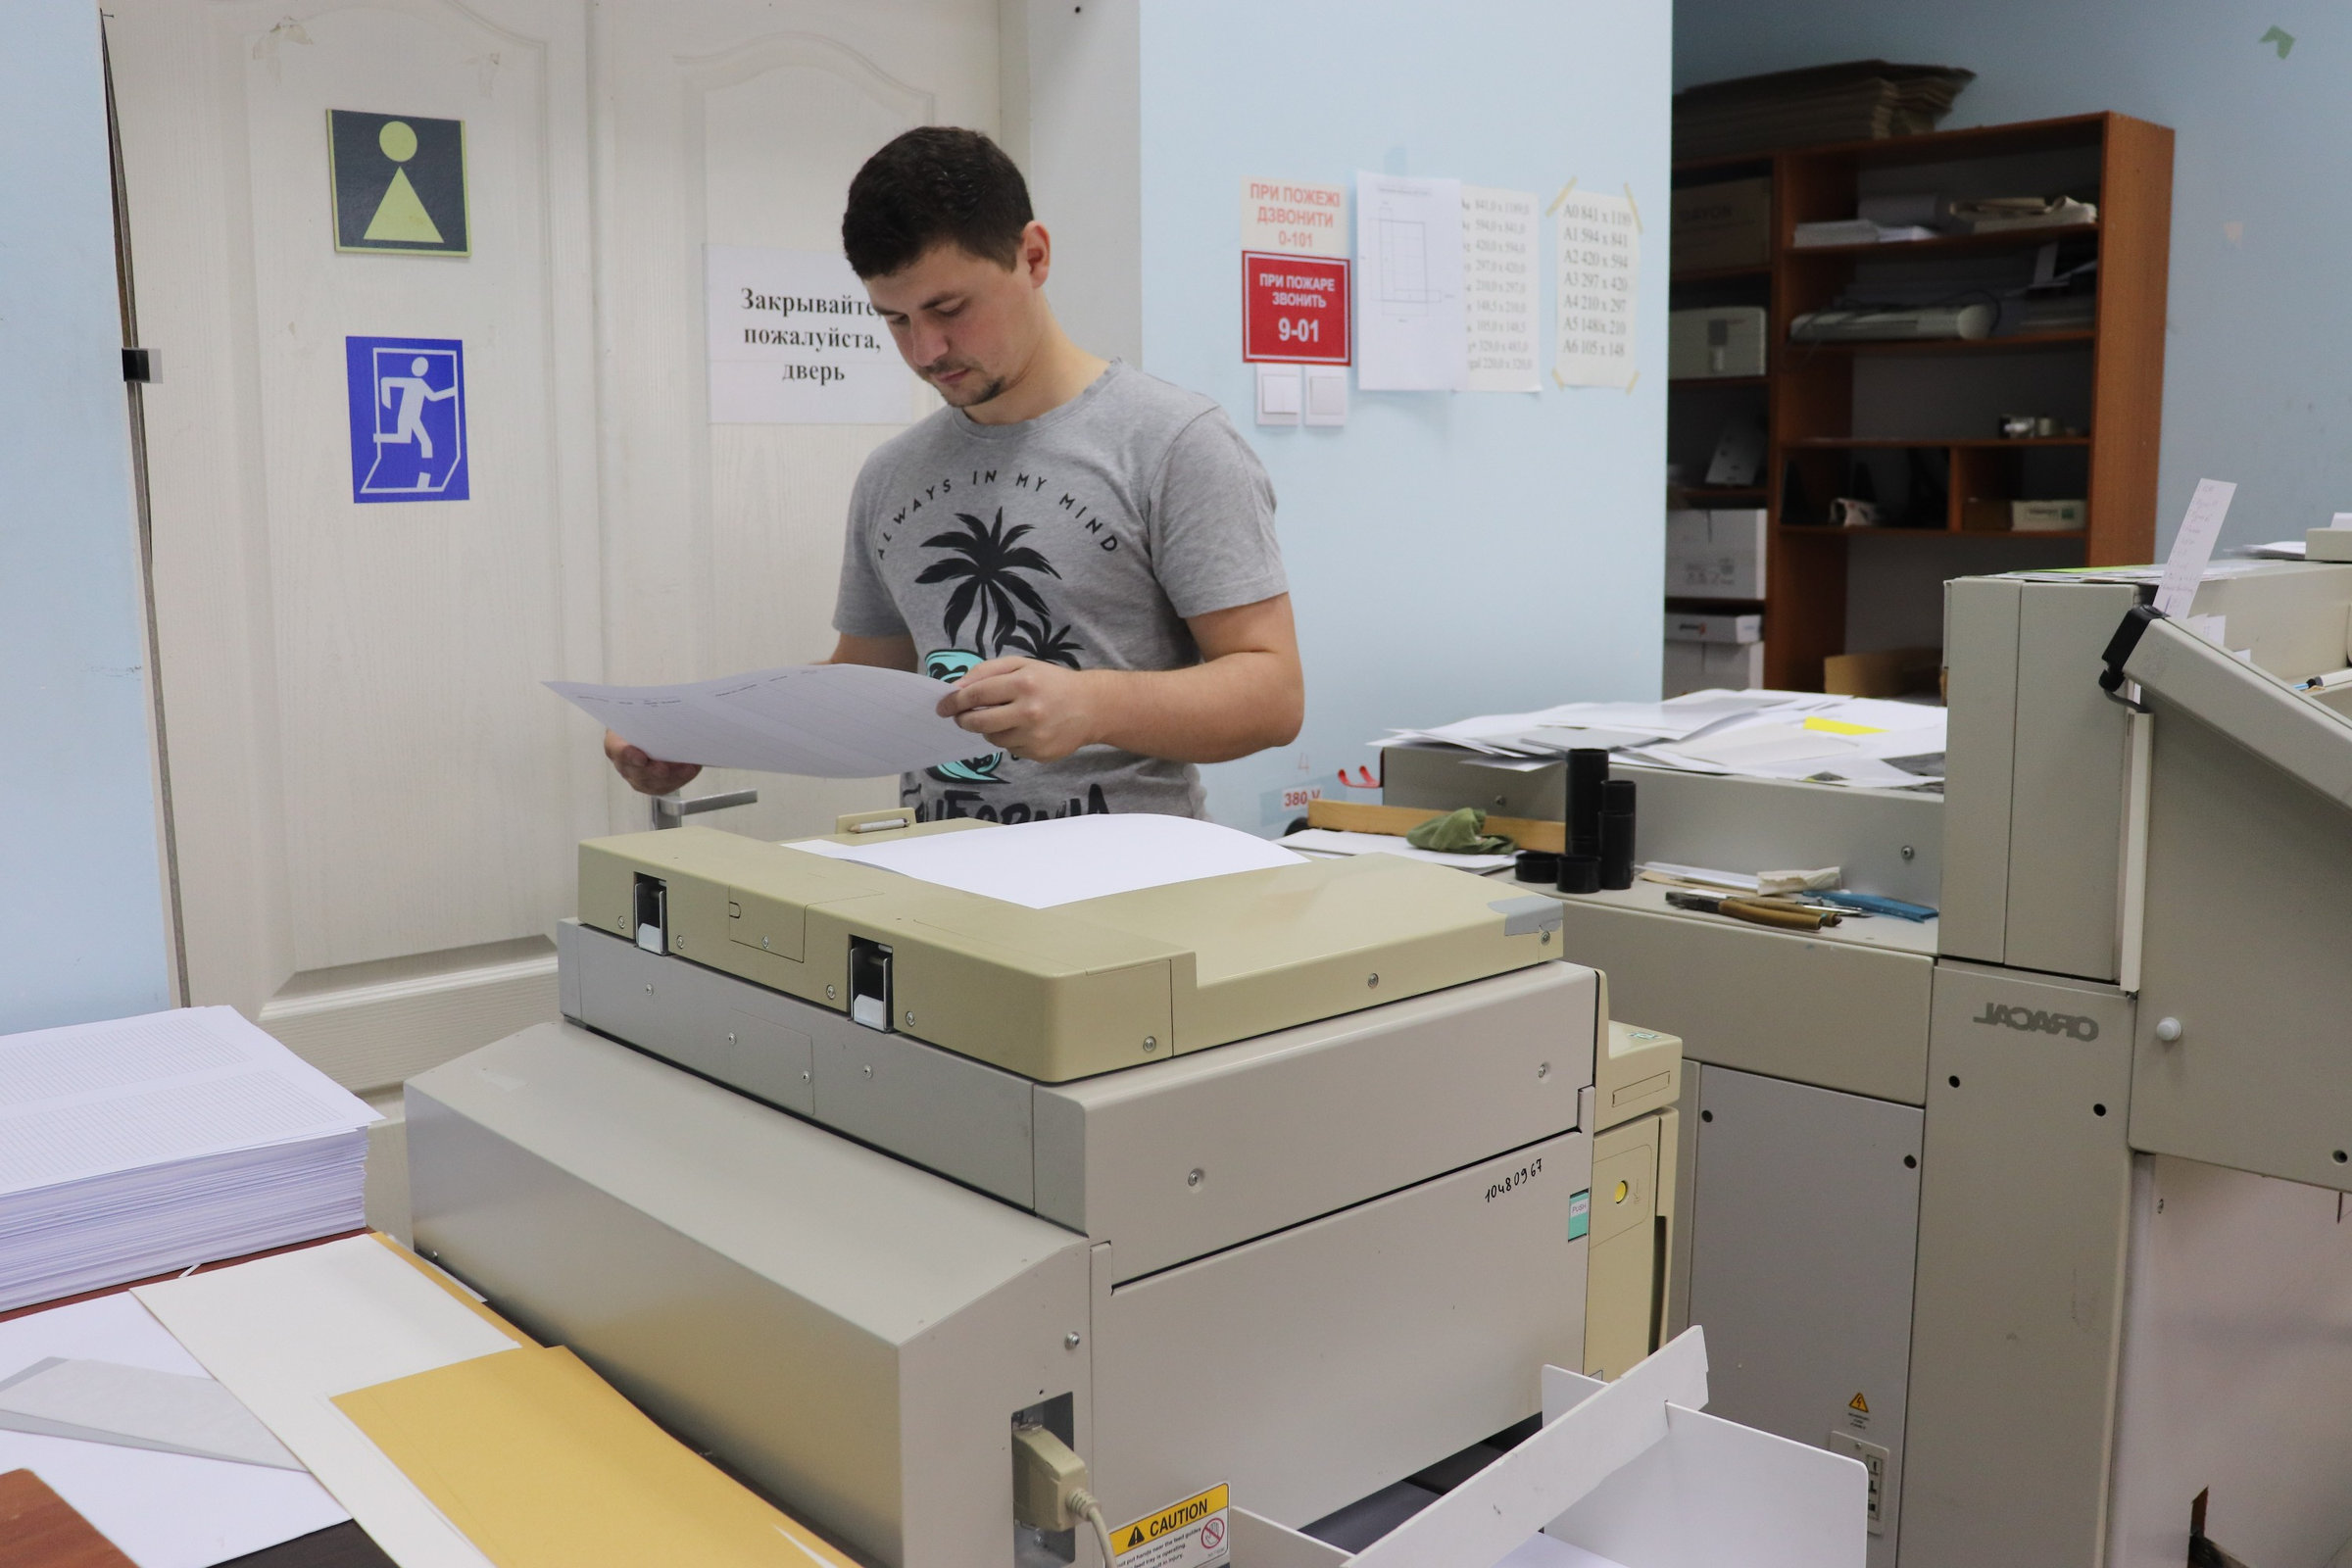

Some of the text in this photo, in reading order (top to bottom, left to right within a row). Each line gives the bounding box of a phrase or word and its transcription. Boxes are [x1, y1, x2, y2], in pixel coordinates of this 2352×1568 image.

[1250, 183, 1279, 202] ПРИ
[1256, 206, 1334, 227] ДЗВОНИТИ
[1563, 204, 1579, 220] A0
[1581, 205, 1597, 221] 841
[1278, 230, 1313, 248] 0-101
[1563, 226, 1577, 242] A1
[1581, 227, 1598, 243] 594
[1611, 231, 1628, 248] 841
[1563, 249, 1579, 265] A2
[1582, 250, 1599, 267] 420
[1610, 254, 1628, 269] 594
[1259, 273, 1336, 292] ПРИ ПОЖАРЕ
[1563, 271, 1578, 287] A3
[1582, 272, 1599, 288] 297
[1610, 276, 1628, 292] 420
[1272, 292, 1327, 309] ЗВОНИТЬ
[1563, 294, 1578, 309] A4
[1581, 295, 1599, 311] 210
[1610, 298, 1627, 313] 297
[1278, 317, 1320, 343] 9-01
[1563, 316, 1578, 331] A5
[1609, 319, 1627, 335] 210
[744, 328, 882, 353] пожалуйста,
[1563, 339, 1579, 354] A6
[1581, 340, 1597, 355] 105
[782, 364, 846, 385] дверь
[878, 469, 1118, 560] ALWAYS IN MY MIND
[1285, 792, 1307, 806] 380
[1150, 1498, 1207, 1537] CAUTION
[1136, 1549, 1152, 1559] hands
[1185, 1527, 1201, 1540] guides
